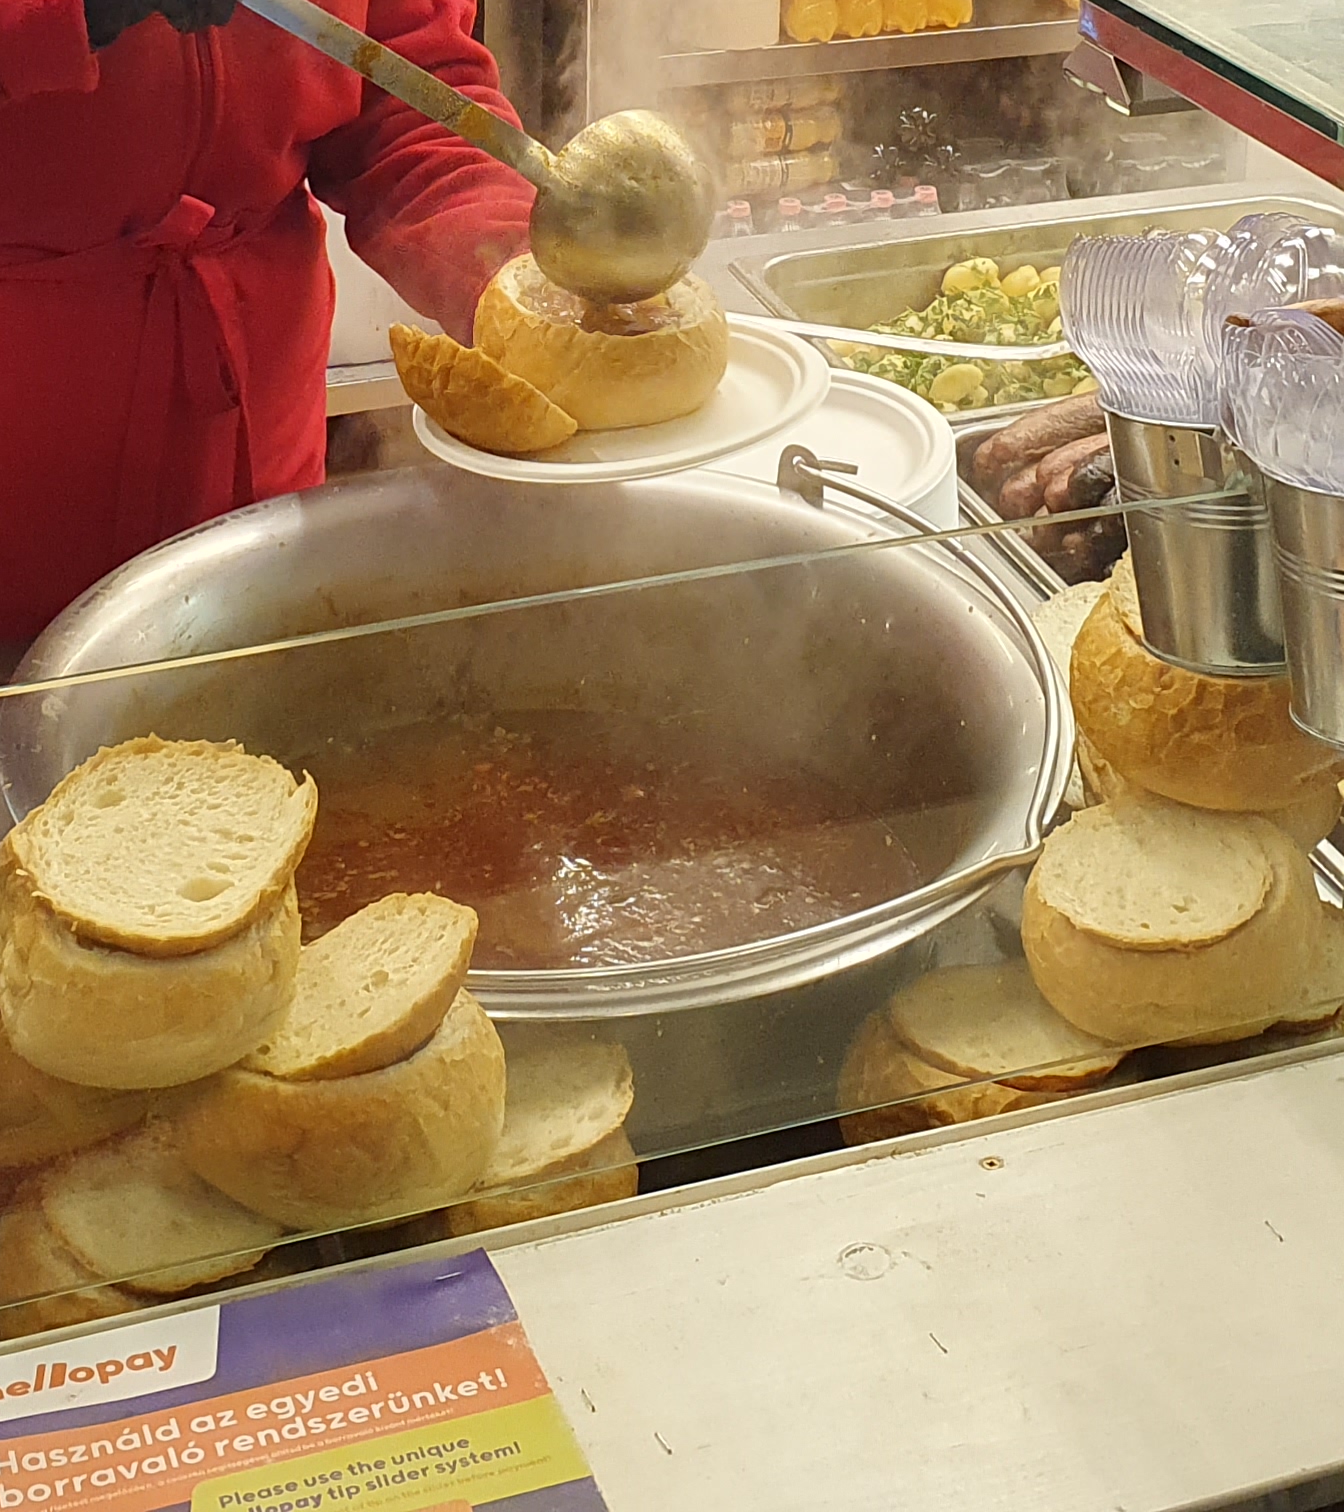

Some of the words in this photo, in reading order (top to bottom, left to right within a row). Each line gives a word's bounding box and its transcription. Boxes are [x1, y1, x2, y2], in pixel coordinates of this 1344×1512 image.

[189, 1408, 239, 1434] az
[245, 1370, 379, 1421] egyedi
[214, 1367, 509, 1458] rendszerünket!
[218, 1480, 299, 1510] Please
[303, 1469, 344, 1489] use
[346, 1458, 387, 1477] the
[390, 1437, 470, 1466] unique
[326, 1484, 362, 1501] tip
[365, 1464, 430, 1492] slider
[433, 1440, 523, 1476] system!
